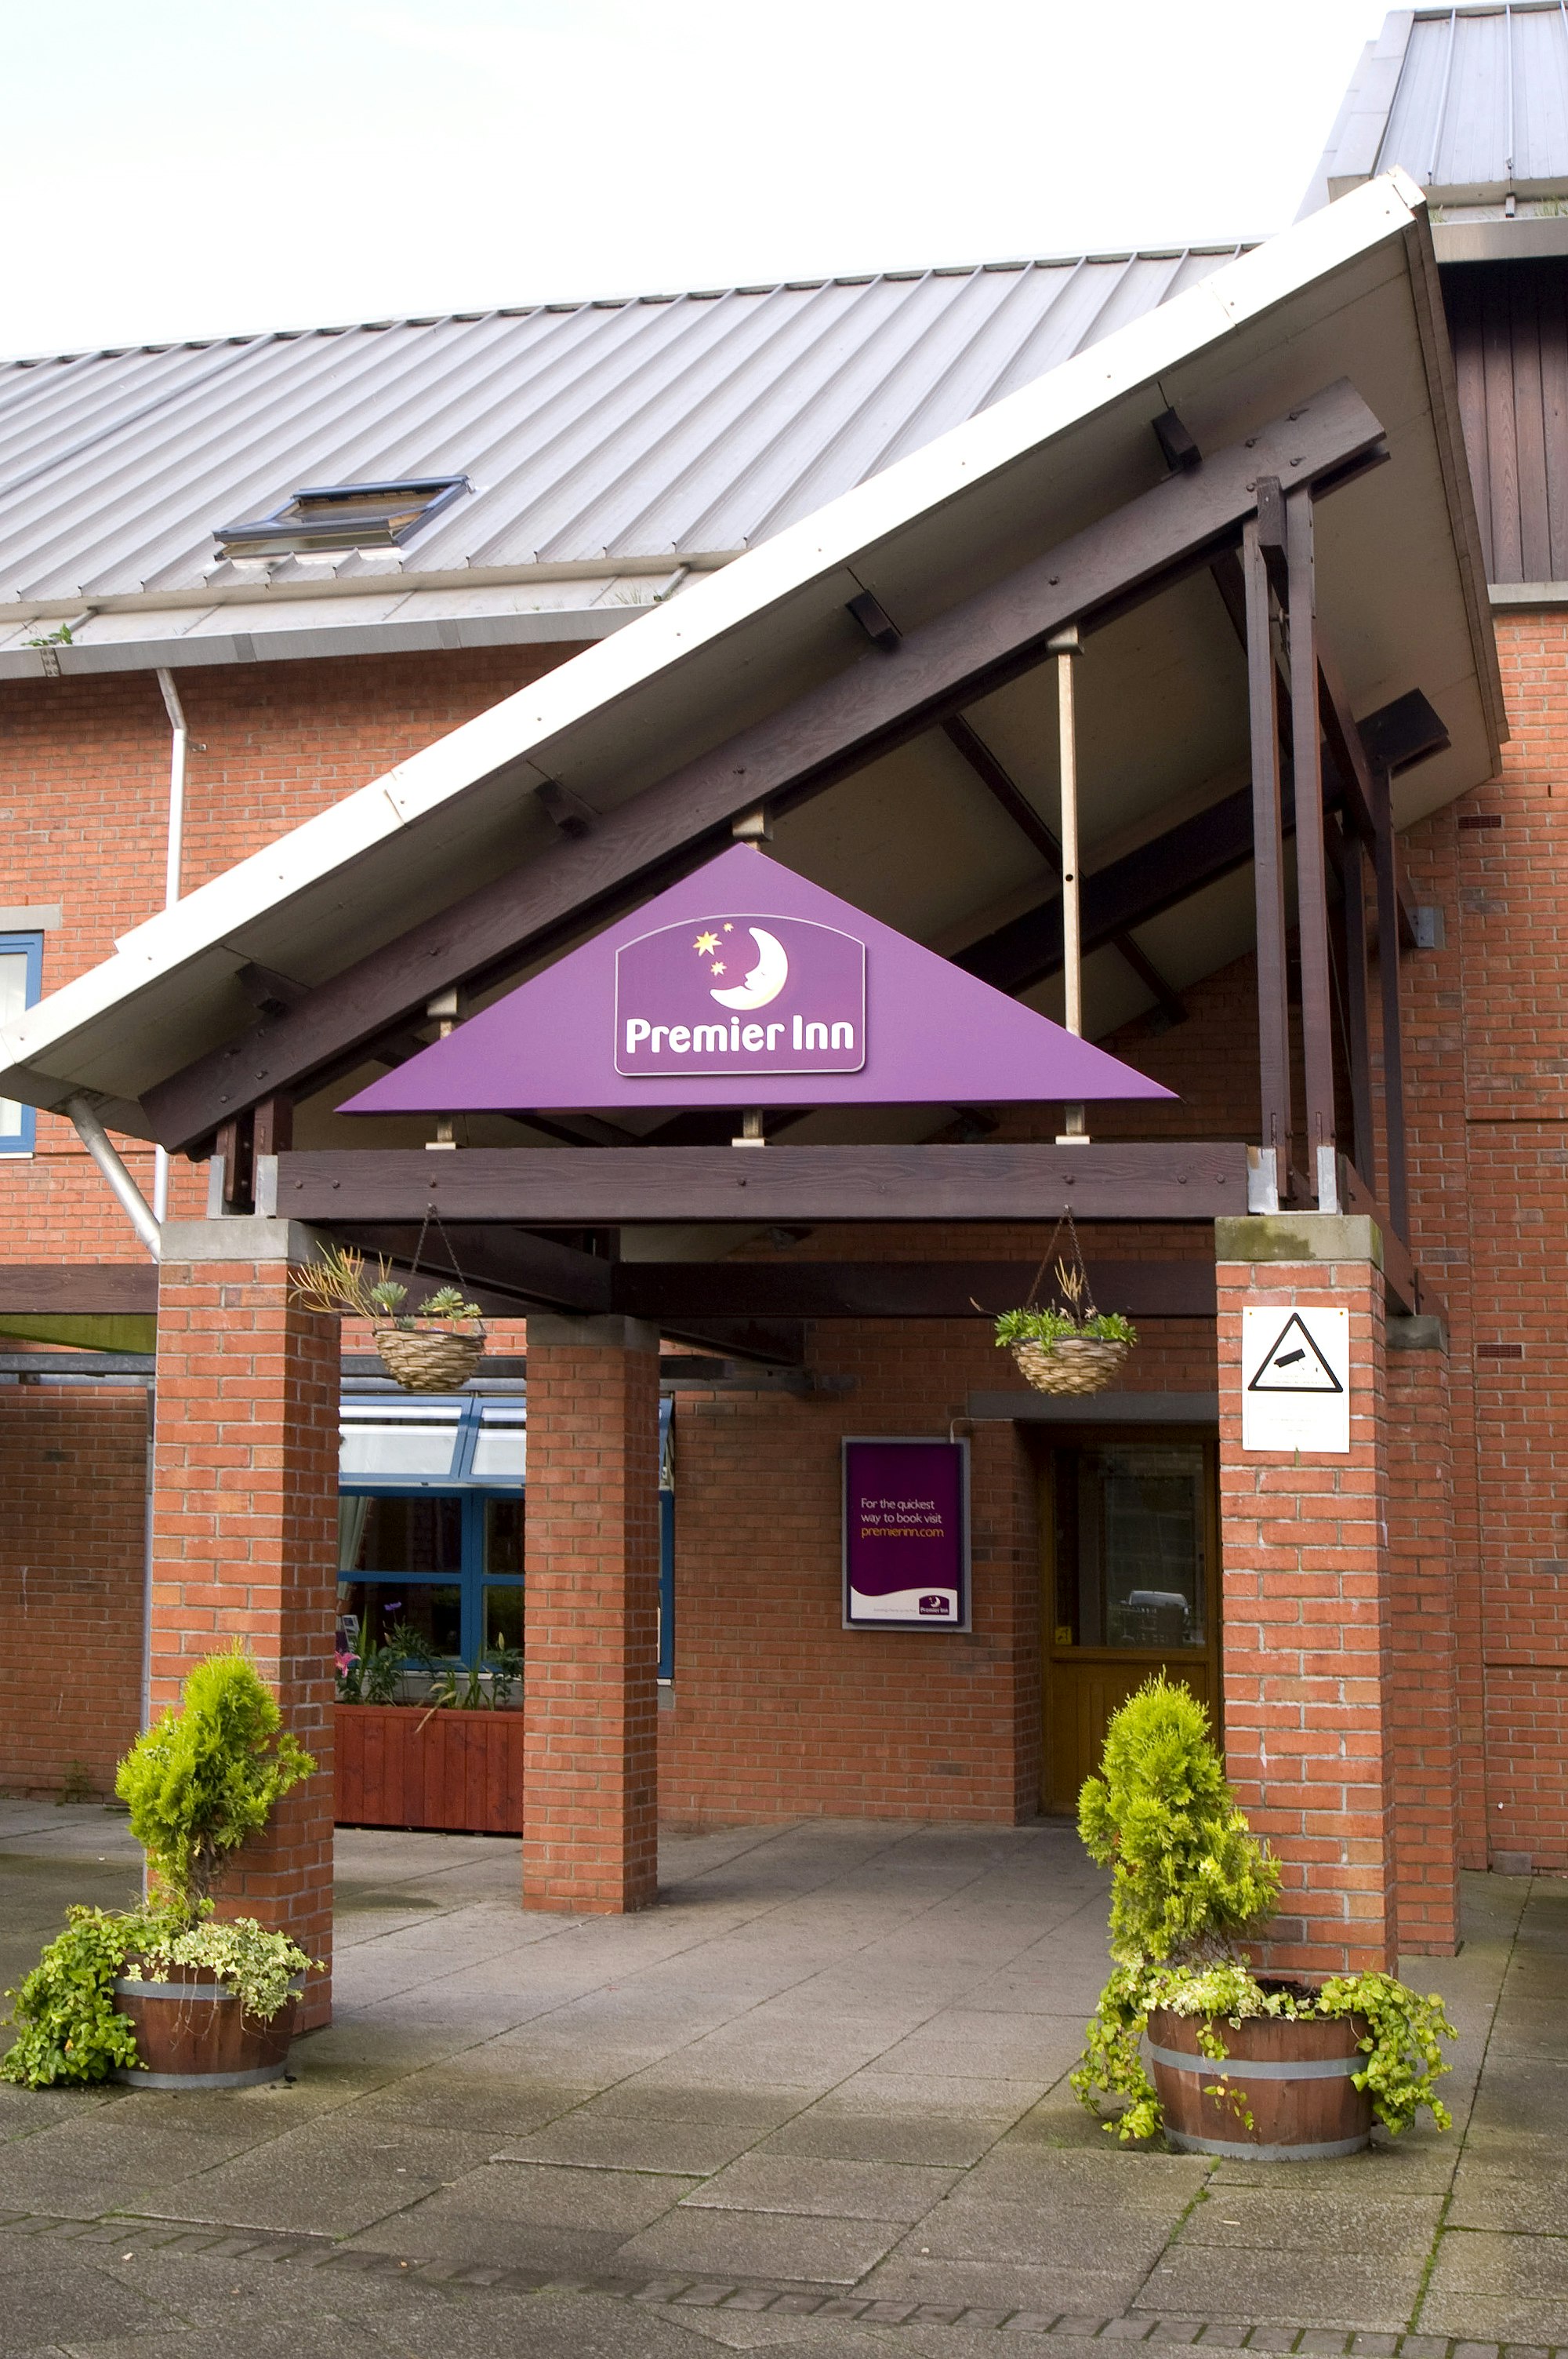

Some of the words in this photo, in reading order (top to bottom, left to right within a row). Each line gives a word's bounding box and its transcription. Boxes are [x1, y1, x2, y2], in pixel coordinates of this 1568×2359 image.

[626, 1016, 785, 1054] Premier
[793, 1015, 854, 1050] Inn
[861, 1497, 878, 1509] For
[880, 1498, 896, 1510] the
[897, 1499, 935, 1511] quickest
[861, 1514, 881, 1525] way
[884, 1513, 895, 1524] to
[896, 1512, 923, 1524] book
[924, 1513, 942, 1524] visit
[861, 1525, 944, 1539] premierinn.com
